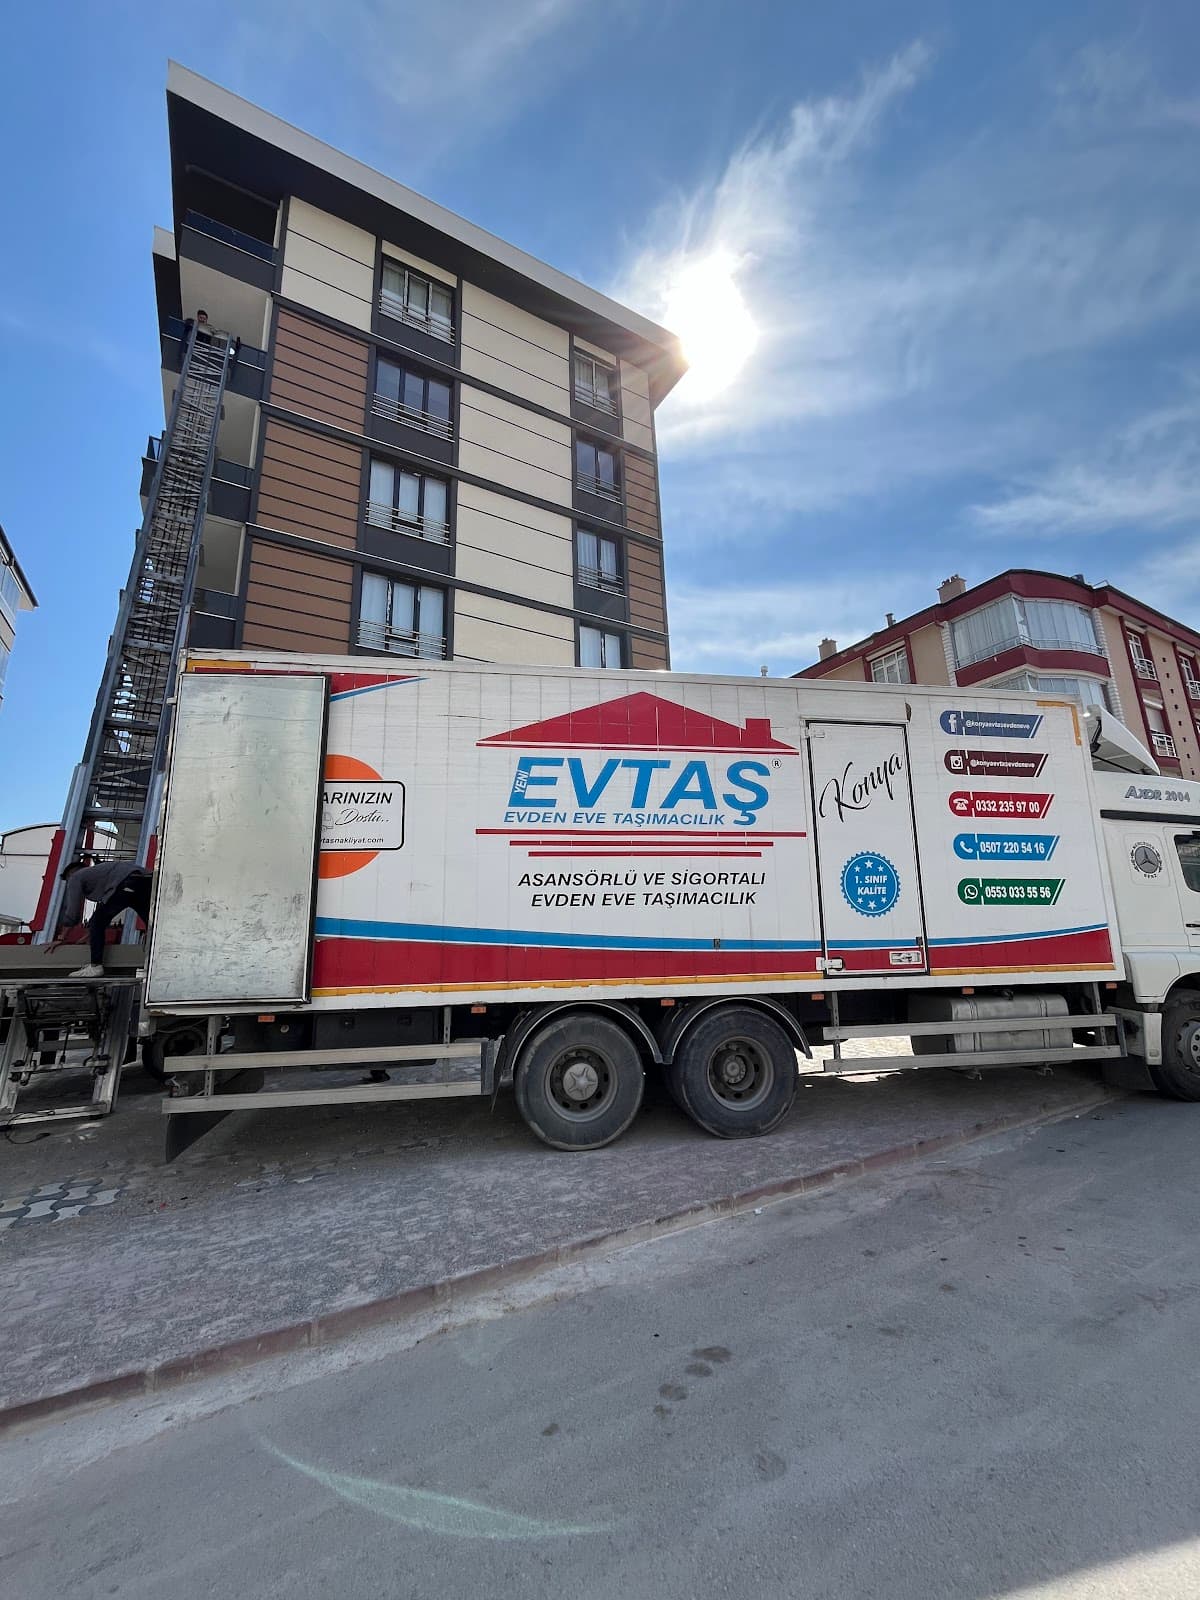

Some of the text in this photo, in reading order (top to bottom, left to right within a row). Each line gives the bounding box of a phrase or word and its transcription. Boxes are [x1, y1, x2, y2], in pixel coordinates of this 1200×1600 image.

[508, 756, 771, 826] EVTAŞ
[819, 752, 902, 823] Konya
[1125, 785, 1191, 802] AXOR 2004
[975, 799, 1040, 813] 0332 235 97 00
[503, 811, 725, 827] EVDEN EVE TAŞIMACILIK
[980, 841, 1045, 854] 0507 220 54 16
[517, 869, 766, 887] ASANSÖRLÜ VE SİGORTALI
[854, 875, 888, 885] 1. SINIF
[857, 886, 887, 896] KALİTE
[985, 886, 1051, 898] 0553 033 55 56
[531, 891, 758, 909] EVDEN EVE TAŞIMACILIK
